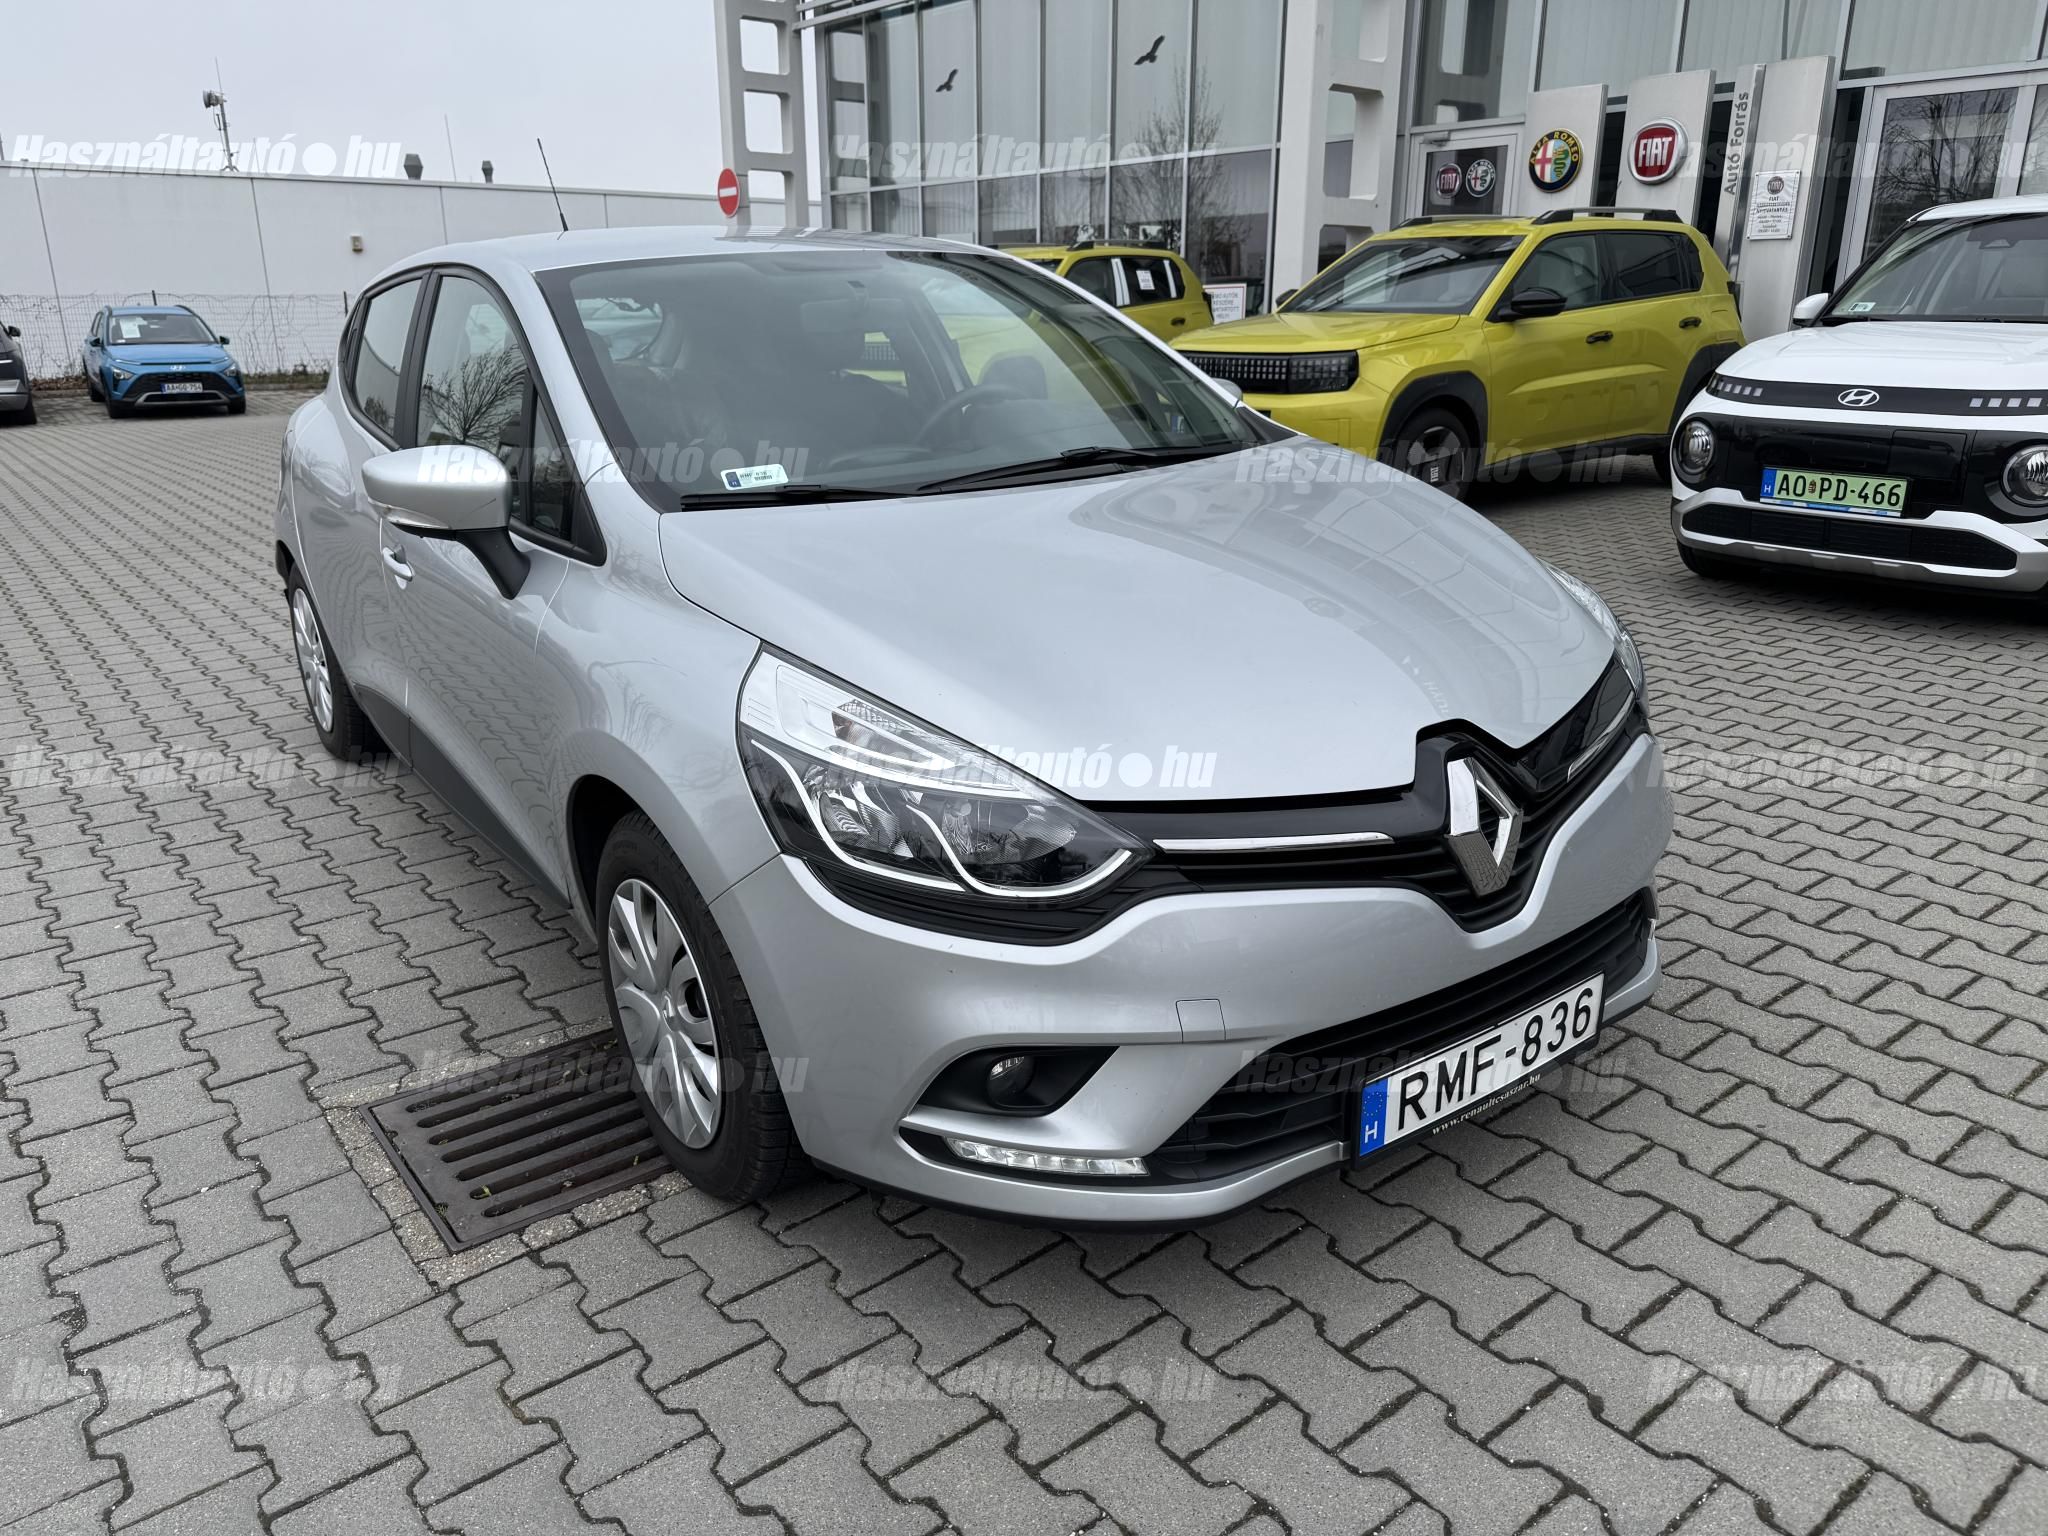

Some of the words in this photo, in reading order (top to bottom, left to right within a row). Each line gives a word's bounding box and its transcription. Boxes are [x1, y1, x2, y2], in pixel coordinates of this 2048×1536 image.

[1730, 91, 1749, 147] Forrás
[1530, 136, 1550, 165] ALFA
[1553, 130, 1579, 162] ROMEO
[1637, 136, 1673, 168] FIAT
[1724, 153, 1741, 195] Autó
[1763, 484, 1772, 493] H
[1777, 473, 1807, 497] AO
[1818, 477, 1902, 507] PD-466
[1397, 987, 1594, 1131] RMF-836
[1431, 1072, 1542, 1136] www.renaultcsaszar.hu
[1364, 1120, 1378, 1144] H
